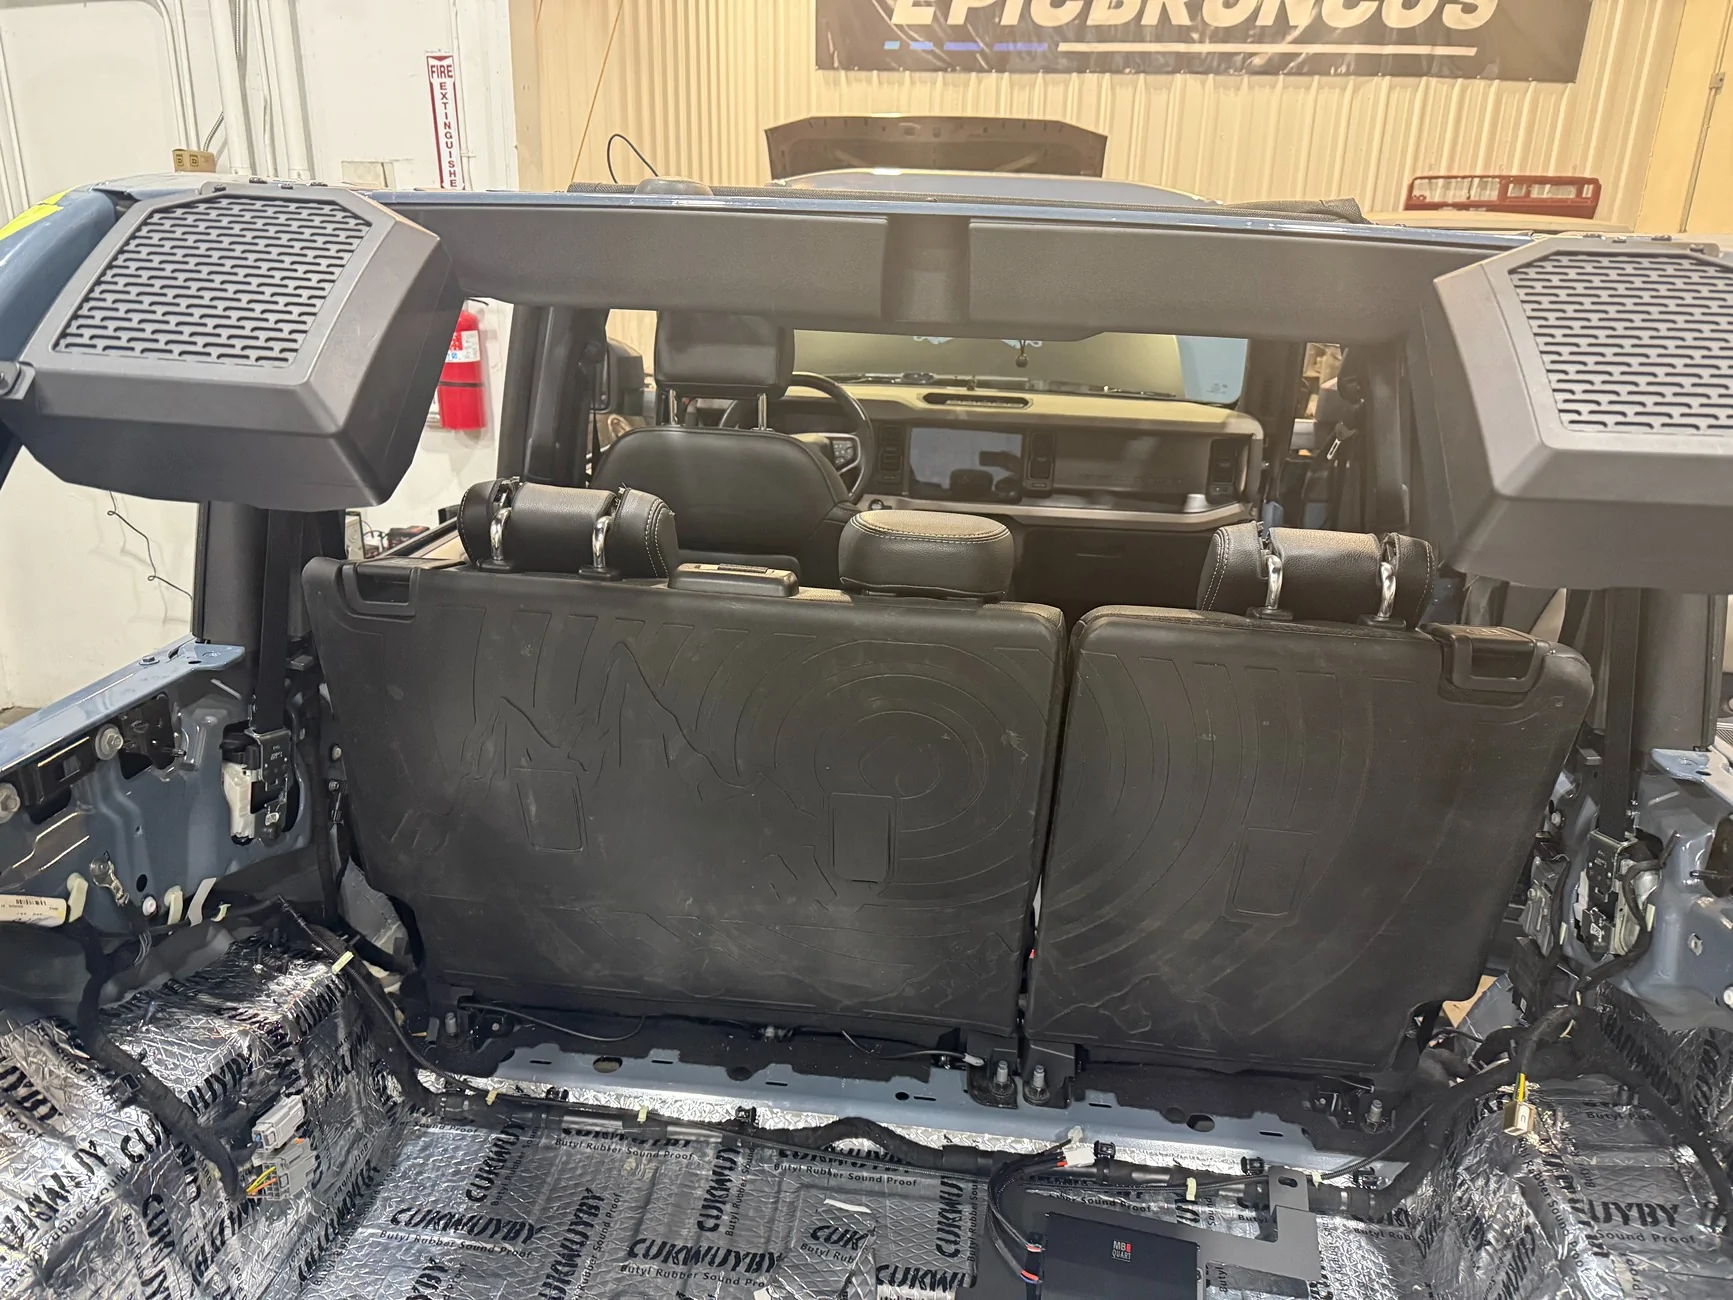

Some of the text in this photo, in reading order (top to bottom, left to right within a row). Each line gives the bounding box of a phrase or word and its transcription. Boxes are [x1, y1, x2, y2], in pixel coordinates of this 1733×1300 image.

[430, 64, 454, 79] FIRE
[439, 81, 458, 188] EXTINGUISHE
[413, 1119, 446, 1130] Sound
[449, 1124, 478, 1134] Proof
[1629, 1112, 1656, 1121] Rub
[465, 1118, 526, 1202] CUKWUY
[503, 1150, 528, 1182] Rubber
[521, 1125, 540, 1149] Soun
[555, 1138, 695, 1161] Butyl Rubber Sound Proof
[90, 1166, 129, 1204] Sound
[773, 1162, 918, 1187] Butyl Rubber Sound Proof
[724, 1147, 756, 1237] Butyl Rubber Sound
[1081, 1197, 1117, 1208] Sound
[1121, 1201, 1152, 1213] Proof
[1524, 1160, 1551, 1199] Rubber
[1548, 1200, 1571, 1237] Sound
[390, 1206, 547, 1245] CUKWUYBY
[935, 1175, 964, 1258] CUKWU
[966, 1179, 979, 1262] Butyl Rubber Sou
[1205, 1197, 1217, 1227] Sound
[1238, 1214, 1269, 1224] Butyl
[123, 1213, 141, 1251] Butyl
[379, 1229, 533, 1259] Butyl Rubber Sound Proof
[537, 1187, 605, 1300] UKWUYBY
[576, 1192, 622, 1292] Rubber Sound Proof
[1113, 1240, 1126, 1251] MB
[1389, 1231, 1413, 1241] Rub
[1596, 1229, 1698, 1245] Sound Proof
[627, 1237, 783, 1274] CUKWUYBY
[800, 1242, 856, 1264] Butyl Rub
[1111, 1250, 1132, 1261] QUART
[620, 1264, 766, 1288] Butyl Rubber Sound Pro
[876, 1264, 978, 1293] CUKWU
[1218, 1265, 1230, 1293] Butyl
